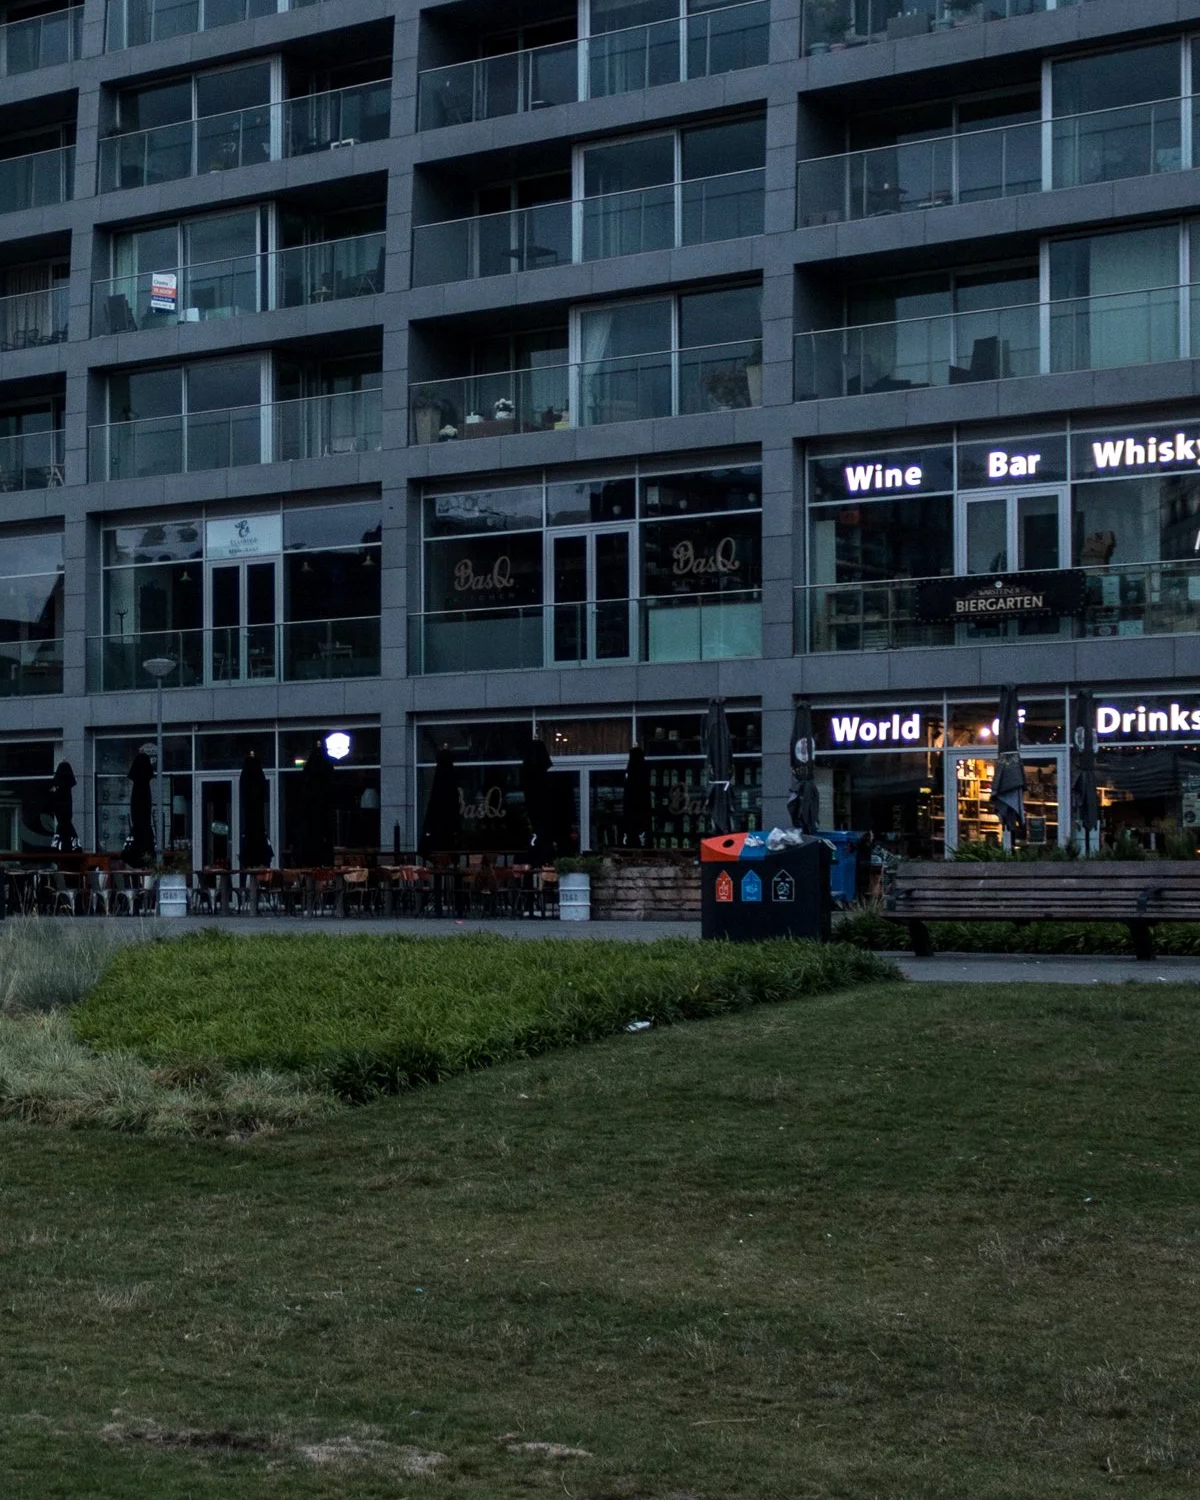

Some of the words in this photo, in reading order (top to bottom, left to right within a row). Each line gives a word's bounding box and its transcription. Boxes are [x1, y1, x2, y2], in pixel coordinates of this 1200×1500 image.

[846, 466, 922, 491] Wine
[988, 452, 1040, 477] Bar
[1092, 433, 1200, 468] Whisk
[454, 556, 514, 591] BasQ
[672, 537, 740, 575] BasQ
[955, 595, 1044, 613] BIERGARTEN
[832, 713, 920, 742] World
